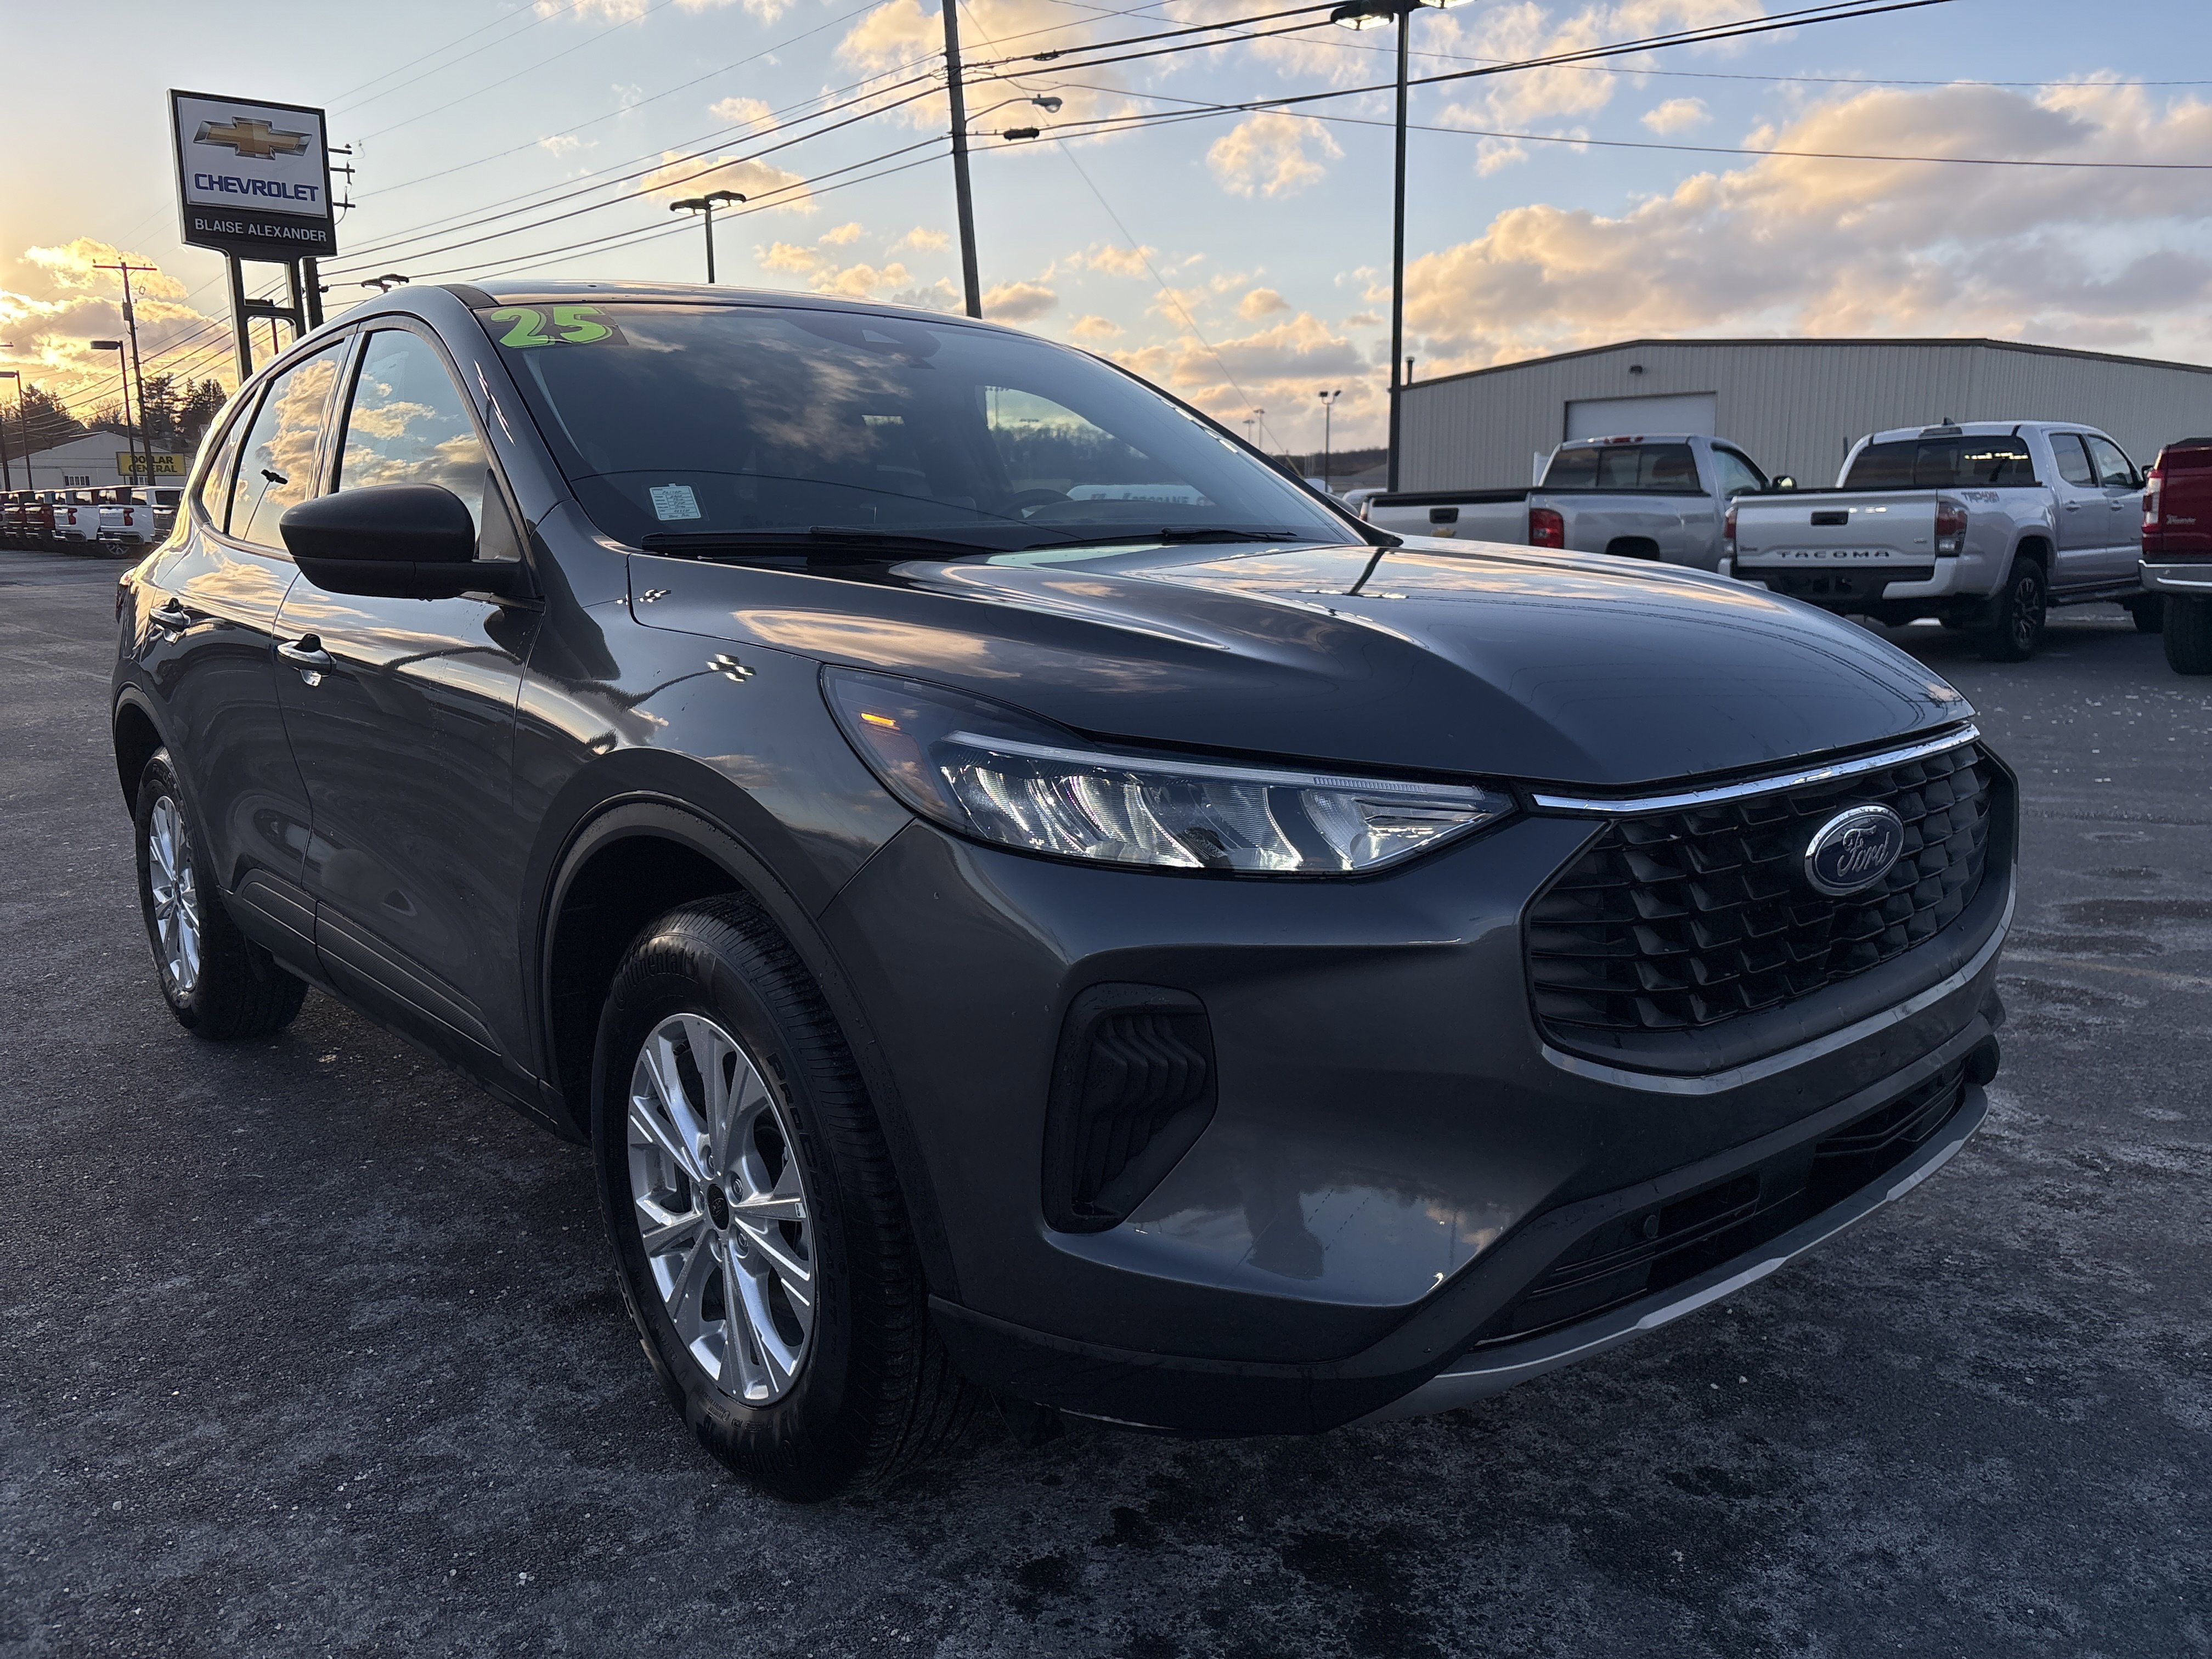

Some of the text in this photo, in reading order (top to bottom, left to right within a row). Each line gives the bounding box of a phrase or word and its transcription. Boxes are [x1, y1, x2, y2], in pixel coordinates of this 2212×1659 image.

[194, 173, 319, 202] CHEVROLET
[194, 218, 327, 242] BLAISE ALEXANDER
[490, 306, 613, 348] 25
[130, 455, 174, 464] DOLAR
[1776, 550, 1890, 559] TACOMA
[1837, 825, 1890, 877] Ford
